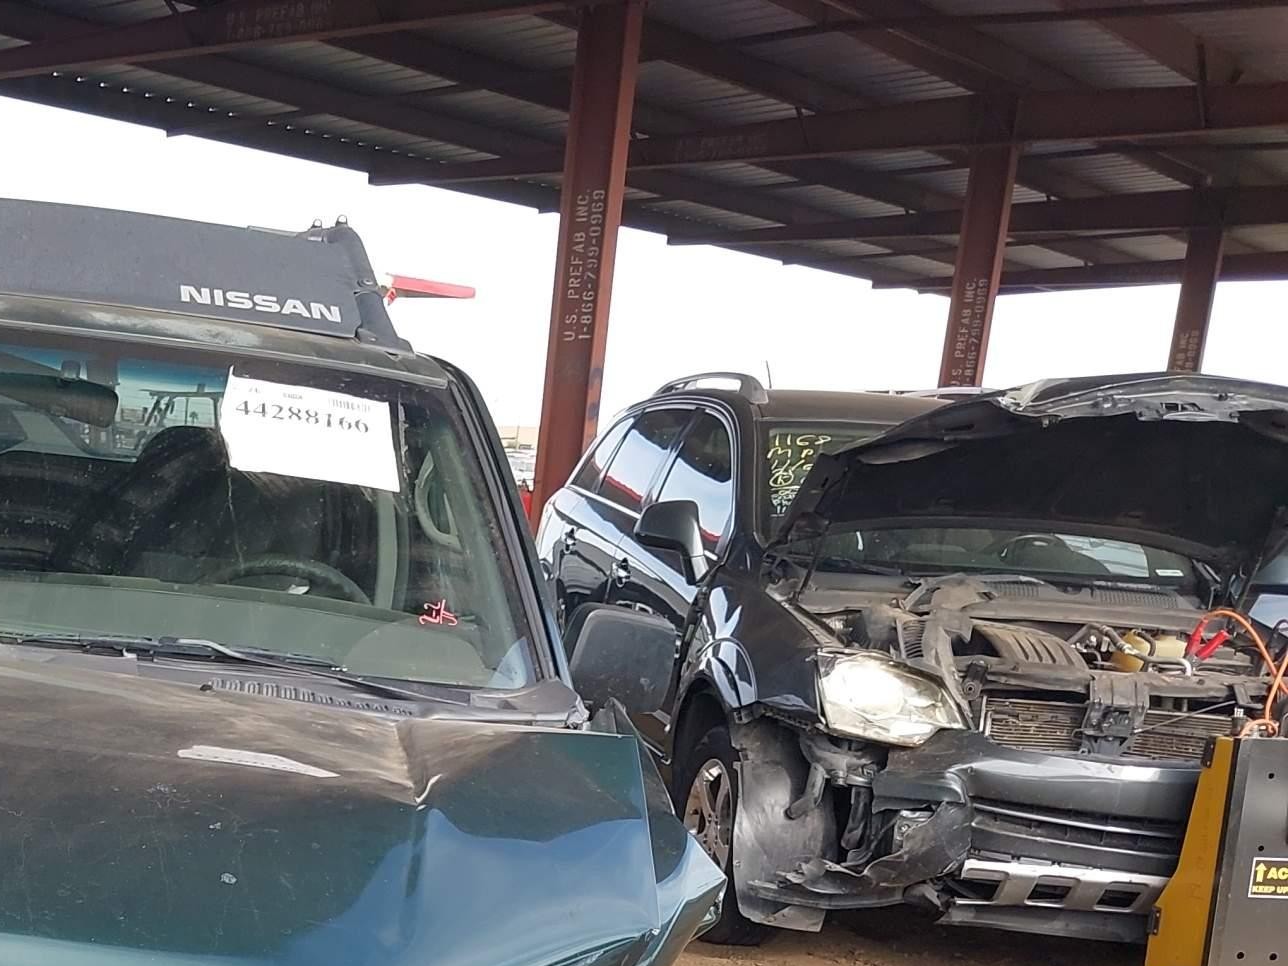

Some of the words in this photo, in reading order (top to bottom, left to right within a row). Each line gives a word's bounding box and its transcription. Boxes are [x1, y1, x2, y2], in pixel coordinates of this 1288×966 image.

[575, 188, 591, 222] INC.
[568, 231, 585, 299] PREFAB
[578, 189, 606, 340] 1-866-799-0969
[180, 285, 342, 323] NISSAN
[562, 308, 579, 341] U.S.
[954, 308, 972, 358] PREFAB
[235, 400, 369, 434] 44288166
